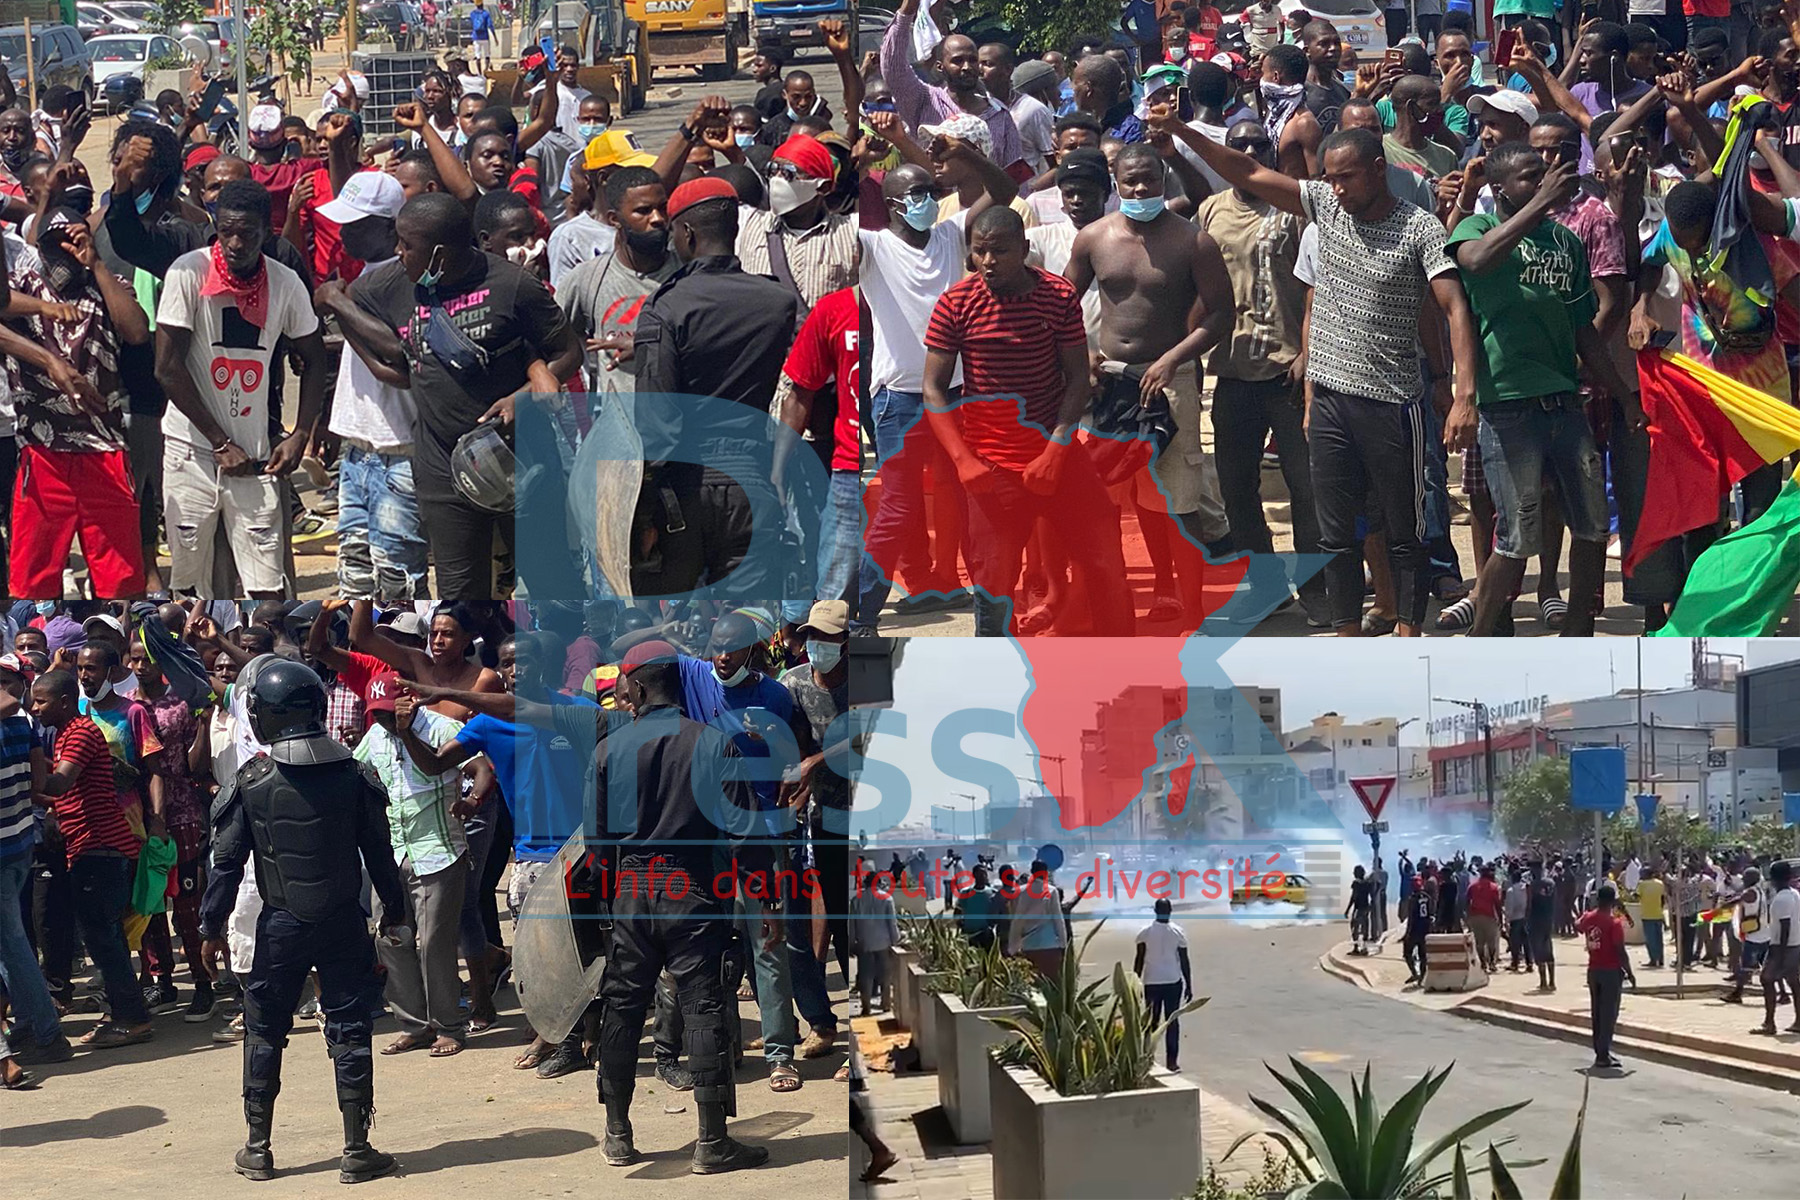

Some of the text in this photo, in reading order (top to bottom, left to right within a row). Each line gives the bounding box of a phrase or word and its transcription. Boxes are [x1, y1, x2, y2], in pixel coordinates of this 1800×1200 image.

[646, 1, 694, 13] SANY
[230, 388, 240, 418] WHO
[371, 680, 386, 699] NY
[1489, 695, 1549, 721] SANITAIRE
